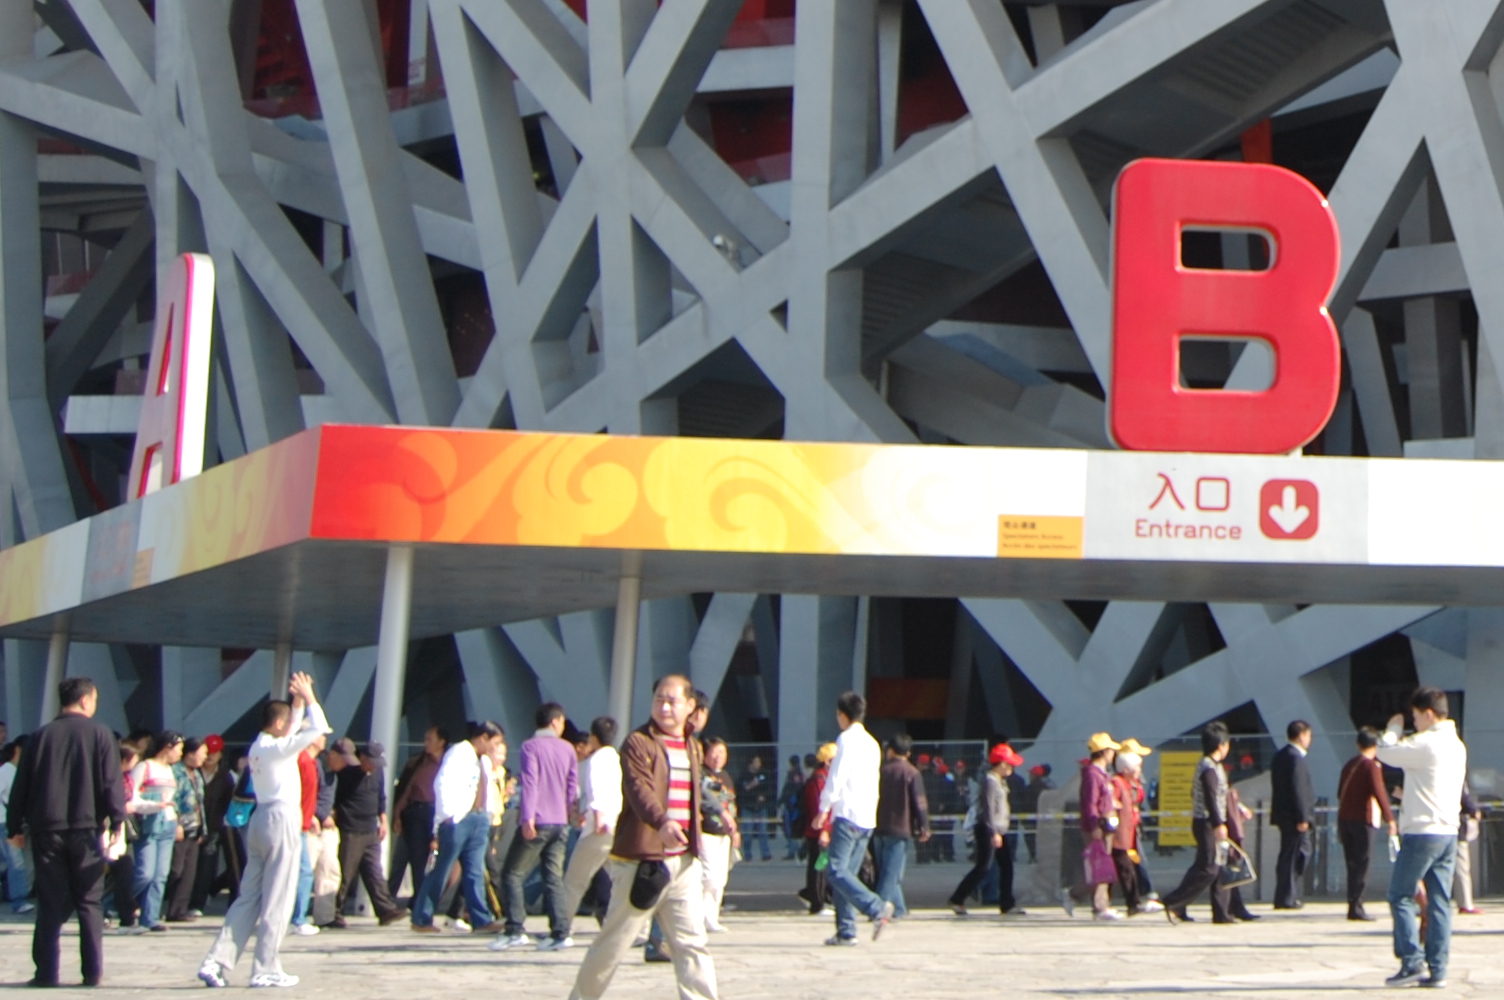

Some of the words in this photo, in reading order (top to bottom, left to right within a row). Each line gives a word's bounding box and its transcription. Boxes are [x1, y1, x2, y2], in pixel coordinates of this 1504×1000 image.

[127, 252, 214, 503] A
[1107, 157, 1342, 454] B
[1135, 518, 1242, 540] Entrance
[1148, 472, 1230, 512] 入口
